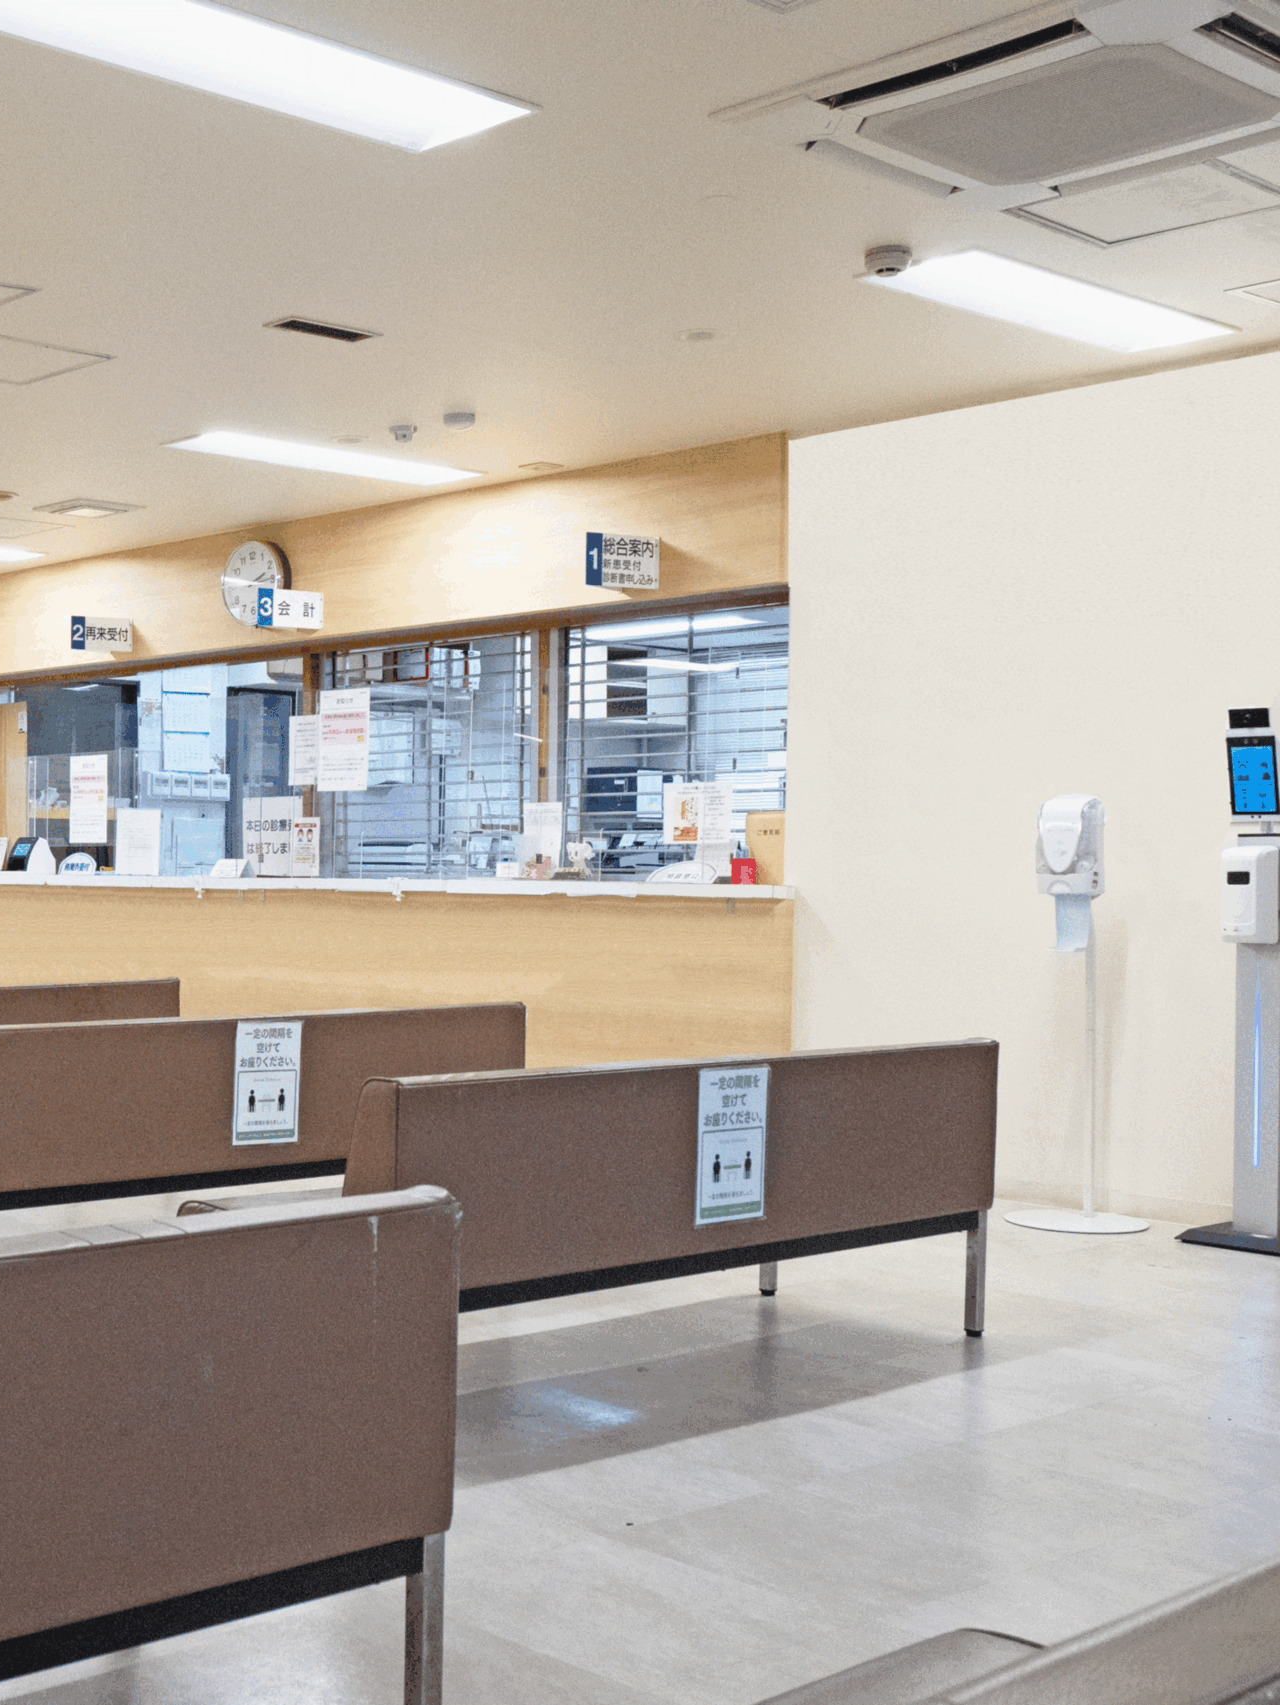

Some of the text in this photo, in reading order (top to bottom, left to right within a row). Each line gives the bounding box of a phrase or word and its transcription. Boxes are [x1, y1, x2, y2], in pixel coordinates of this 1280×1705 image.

[249, 551, 256, 560] 12
[589, 537, 654, 570] 1 総合案内
[267, 560, 273, 570] 2
[603, 558, 642, 571] 新患受付
[603, 572, 654, 585] 診断書申し込み
[234, 595, 240, 605] 8
[241, 604, 247, 613] 7
[251, 606, 256, 615] 6
[259, 597, 272, 616] 3
[72, 624, 129, 642] 2 再来受付
[245, 1028, 293, 1040] 一定の間隔を
[256, 1042, 281, 1054] 空けて
[240, 1056, 296, 1068] お座りください。
[710, 1075, 760, 1090] 一定の間隔を
[721, 1094, 747, 1108] 空けて
[703, 1111, 762, 1127] お座りください。
